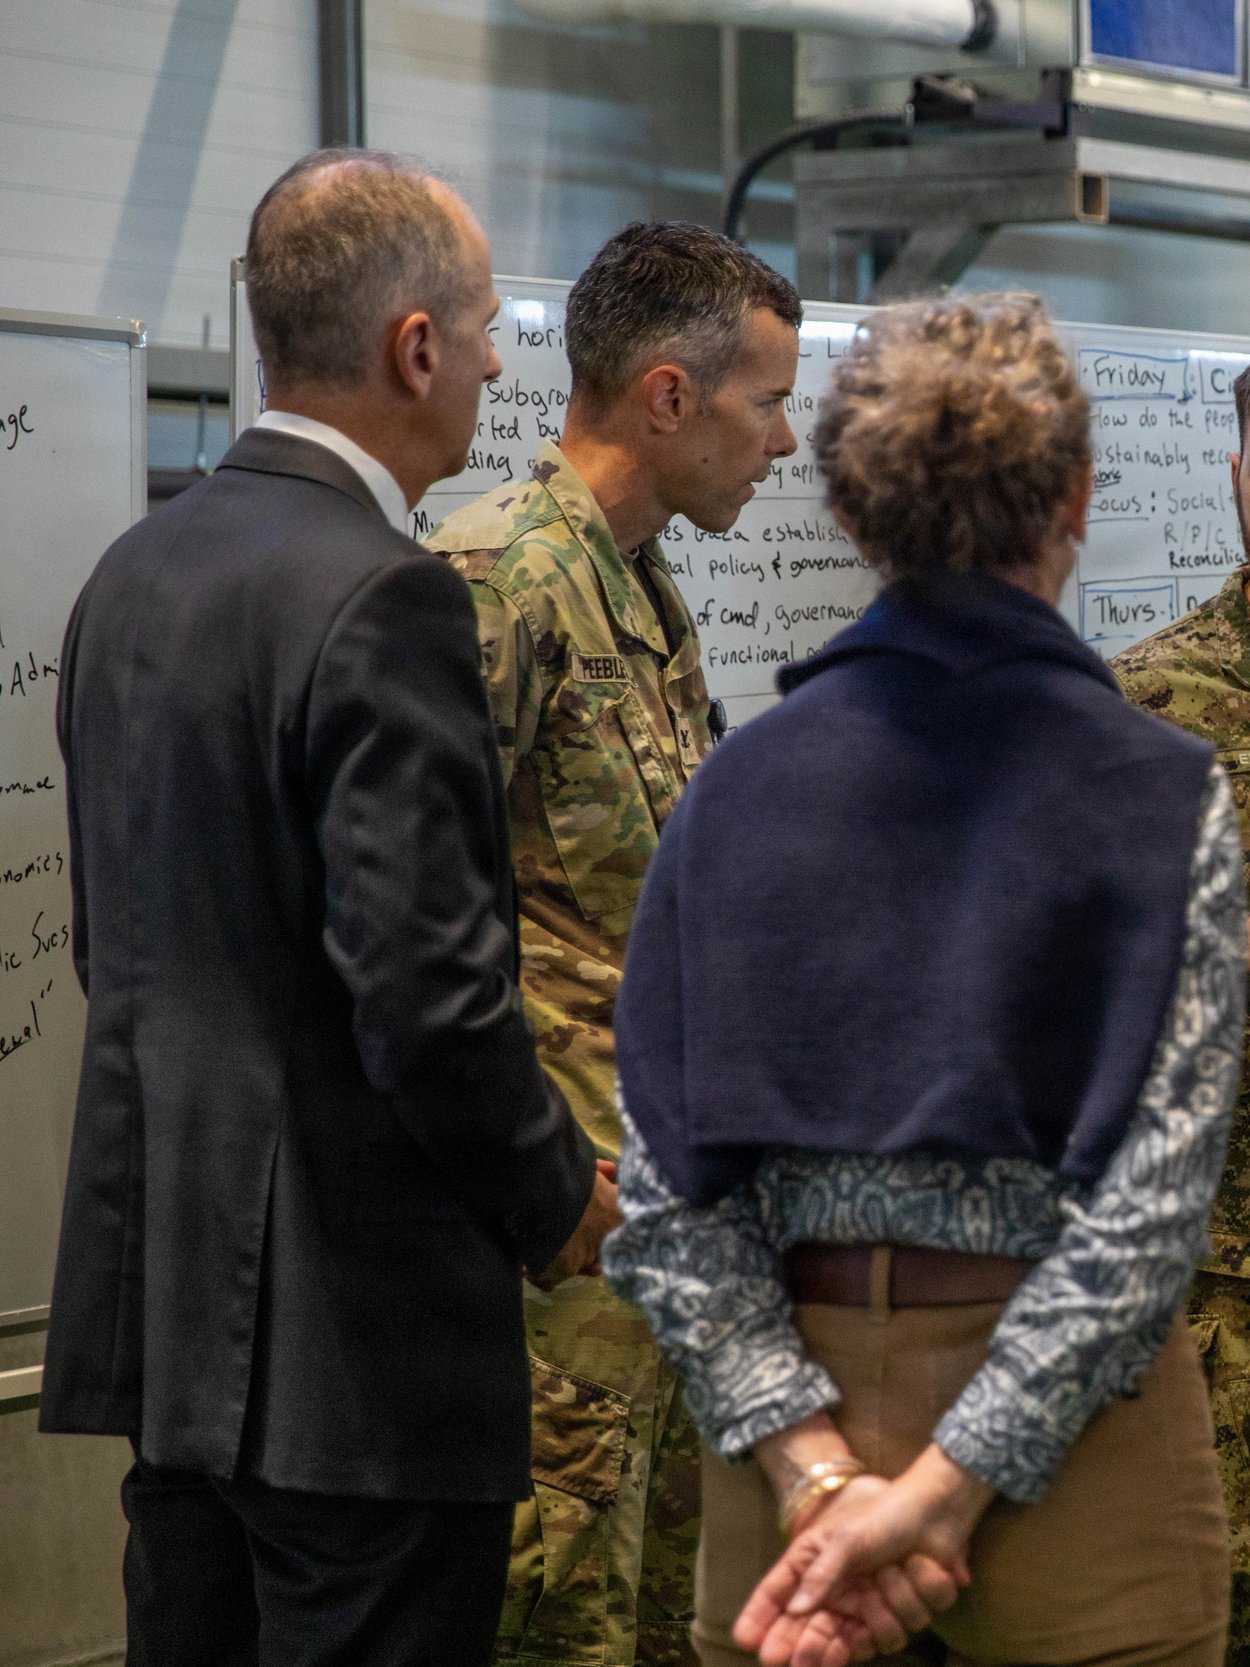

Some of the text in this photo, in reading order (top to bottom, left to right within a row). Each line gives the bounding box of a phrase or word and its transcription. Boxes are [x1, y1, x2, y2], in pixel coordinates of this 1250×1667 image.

[1093, 355, 1166, 393] Friday
[1138, 405, 1158, 427] do
[1168, 406, 1194, 428] the
[1090, 441, 1192, 475] ustainably
[1167, 487, 1226, 514] Social
[708, 553, 765, 582] policy
[695, 599, 715, 627] of
[0, 852, 63, 883] nomics
